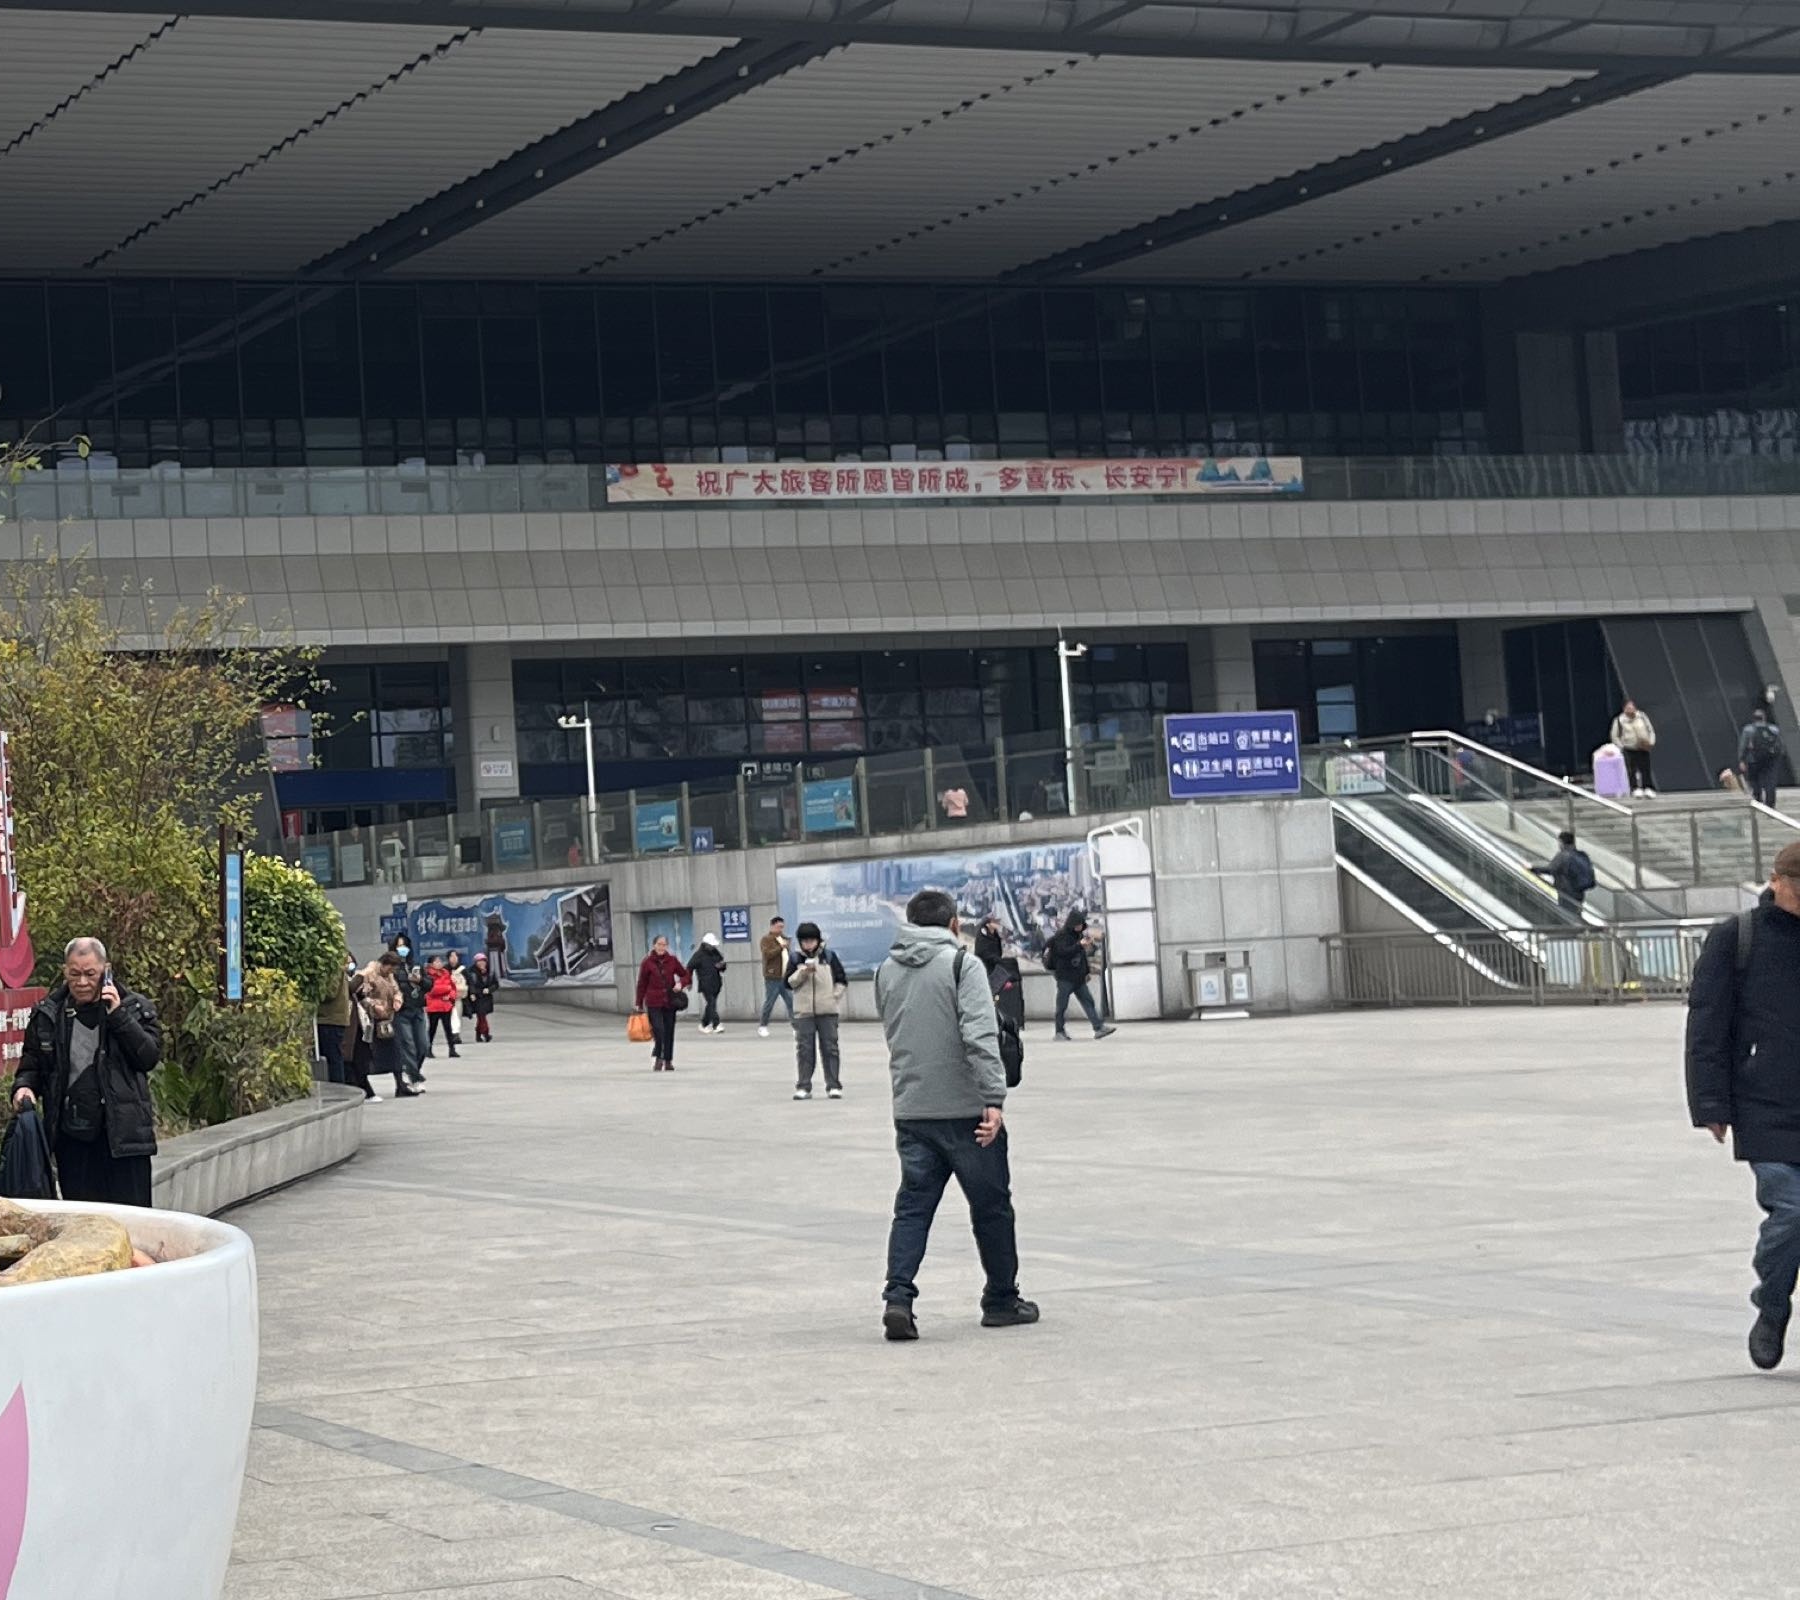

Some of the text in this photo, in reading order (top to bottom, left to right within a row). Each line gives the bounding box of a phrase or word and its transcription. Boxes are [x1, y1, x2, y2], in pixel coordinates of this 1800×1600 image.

[1200, 757, 1232, 772] 卫生间
[723, 910, 748, 926] 卫生间
